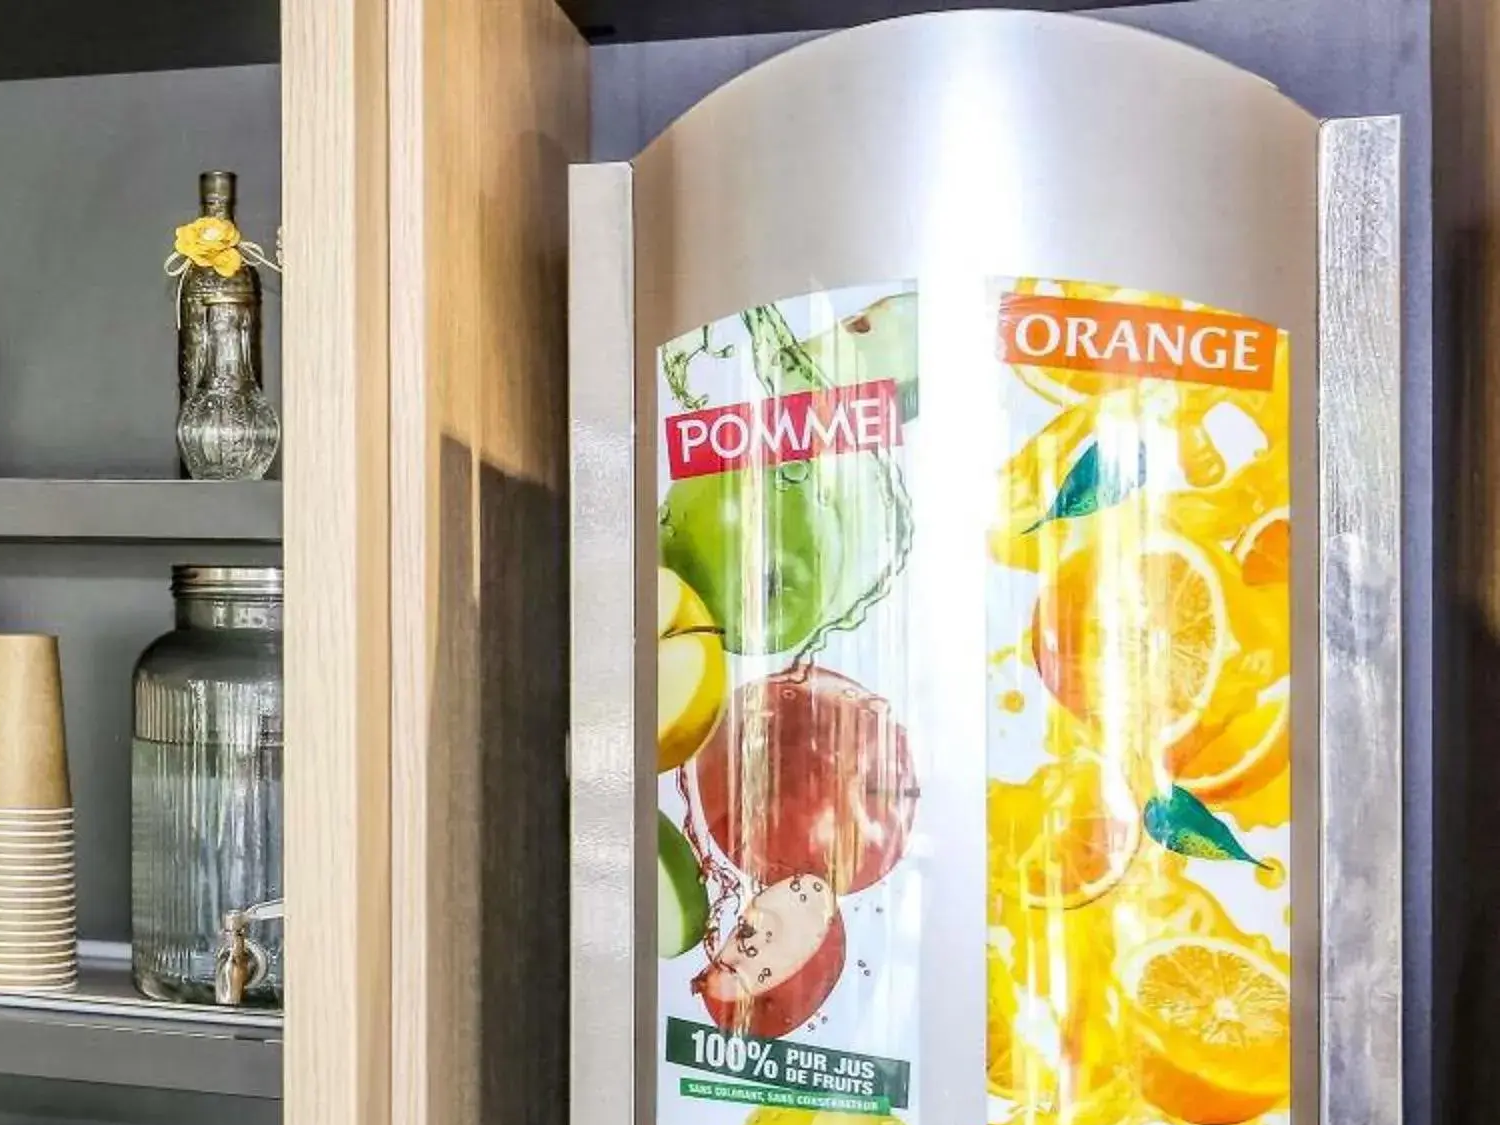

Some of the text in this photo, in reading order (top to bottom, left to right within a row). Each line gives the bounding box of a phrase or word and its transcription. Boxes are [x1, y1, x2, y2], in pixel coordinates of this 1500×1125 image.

[1015, 313, 1260, 372] ORANGE
[691, 1030, 779, 1079] 100%
[786, 1048, 875, 1079] PUR JUS
[688, 1083, 712, 1095] SANS
[767, 1092, 794, 1105] SANS
[786, 1067, 874, 1095] DE FRUITS
